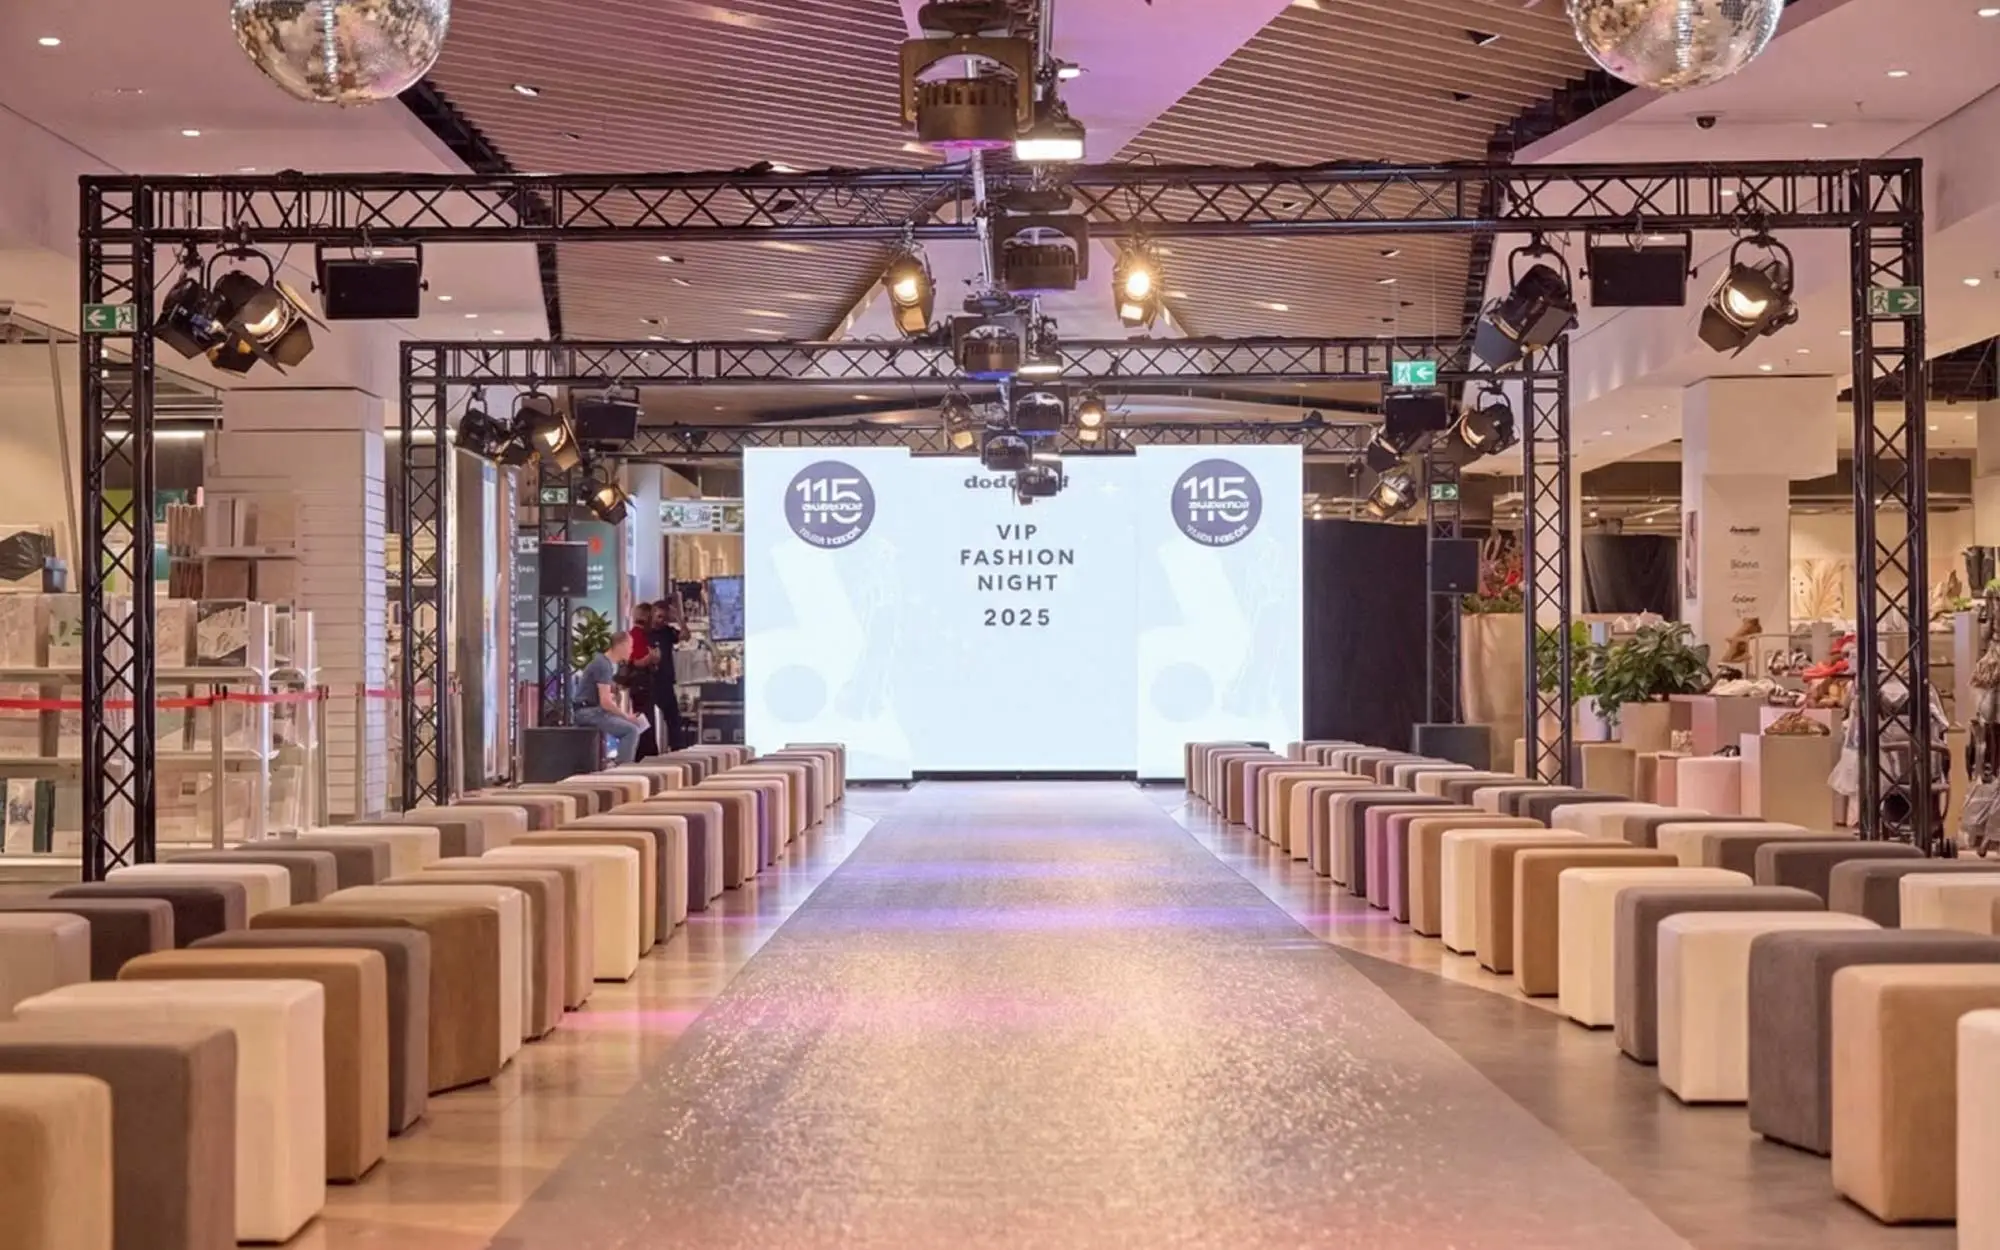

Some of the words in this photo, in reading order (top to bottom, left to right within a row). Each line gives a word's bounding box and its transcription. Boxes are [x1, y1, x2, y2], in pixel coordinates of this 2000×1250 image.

[796, 478, 862, 524] 115
[1182, 476, 1248, 522] 115
[996, 524, 1037, 540] VIP
[960, 549, 1074, 565] FASHION
[977, 574, 1058, 591] NIGHT
[984, 608, 1050, 626] 2025
